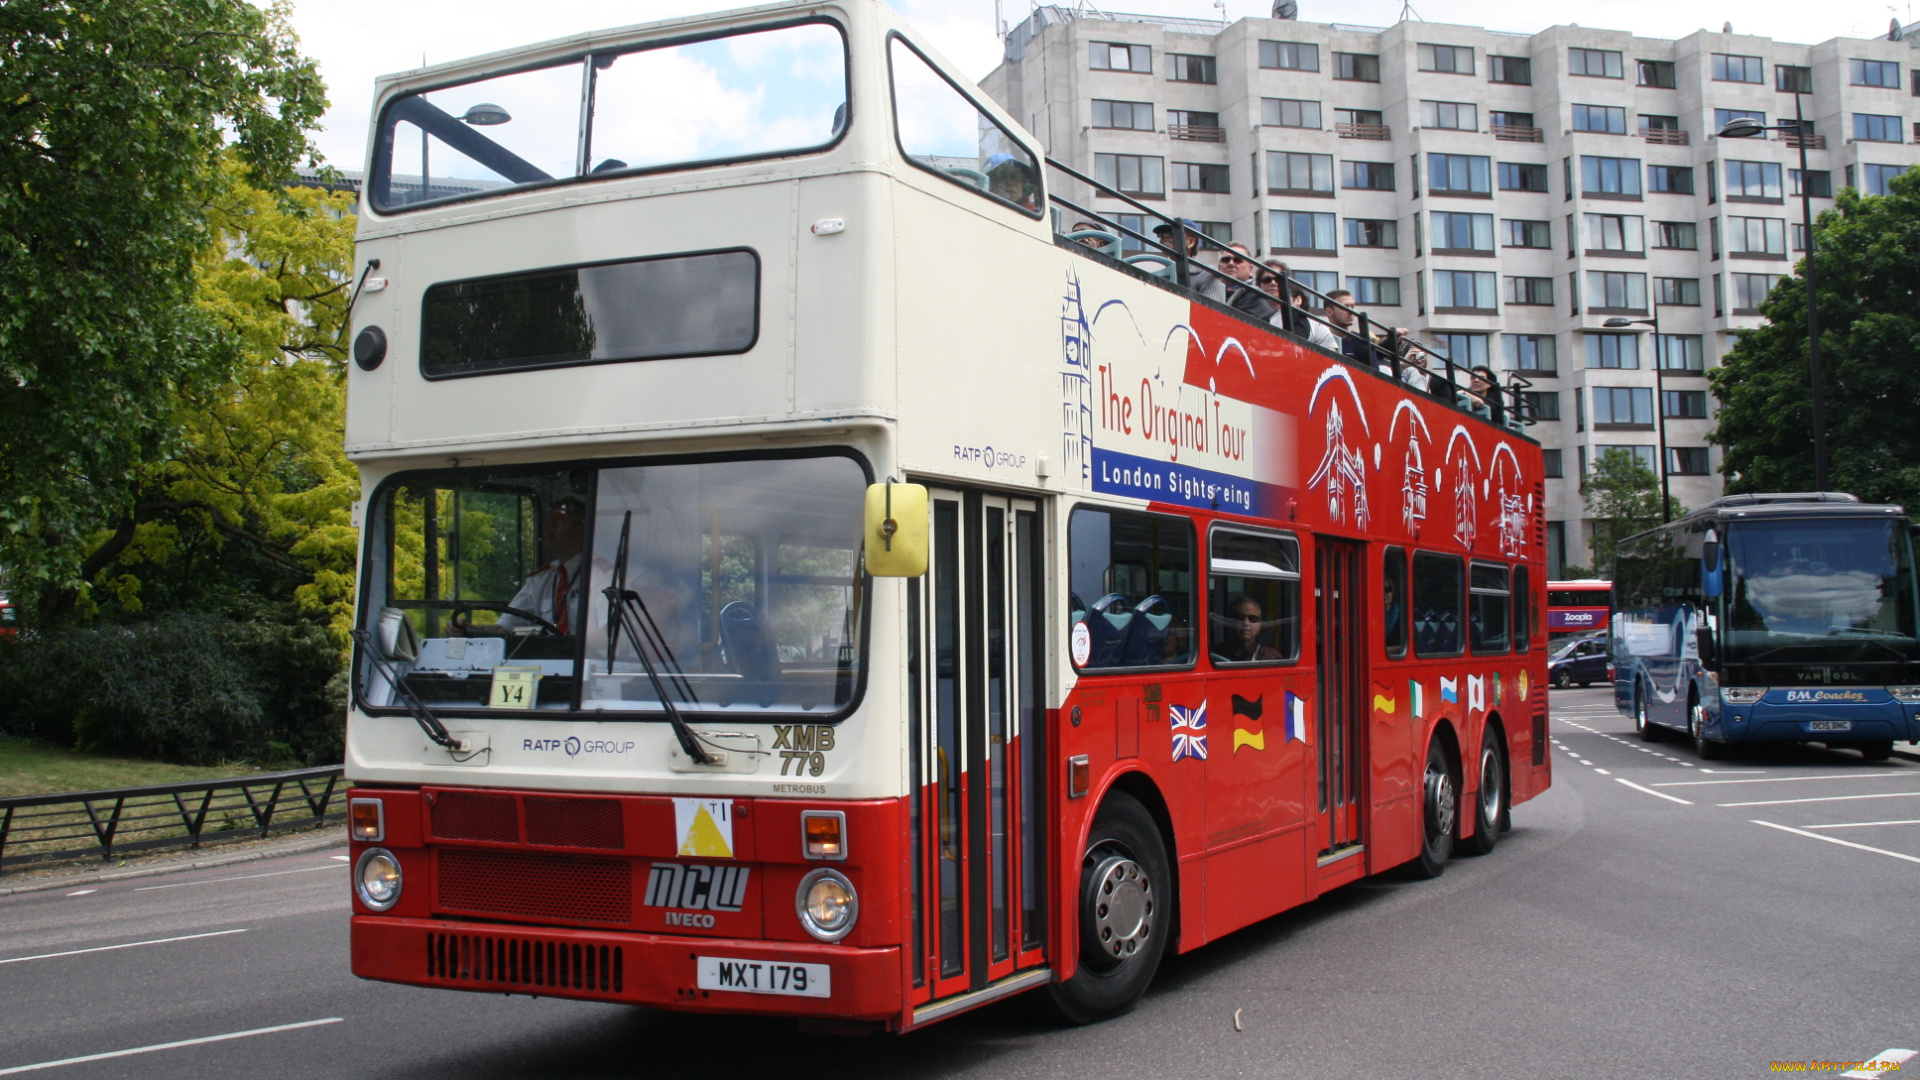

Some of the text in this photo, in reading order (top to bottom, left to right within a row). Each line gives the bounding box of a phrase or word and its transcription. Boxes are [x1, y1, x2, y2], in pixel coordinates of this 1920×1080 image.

[1098, 362, 1247, 462] The Original Tour
[953, 445, 1026, 468] RATP GROUP
[1102, 460, 1162, 490] London
[1564, 612, 1593, 623] Zoopla
[502, 685, 524, 703] Y4
[1786, 690, 1865, 702] BM Coaches
[522, 738, 635, 754] RATP GROUP
[772, 725, 836, 750] XMB
[779, 751, 825, 777] 779
[773, 784, 826, 794] METROBUS
[665, 911, 715, 928] IVECO
[719, 961, 808, 991] MXT 179
